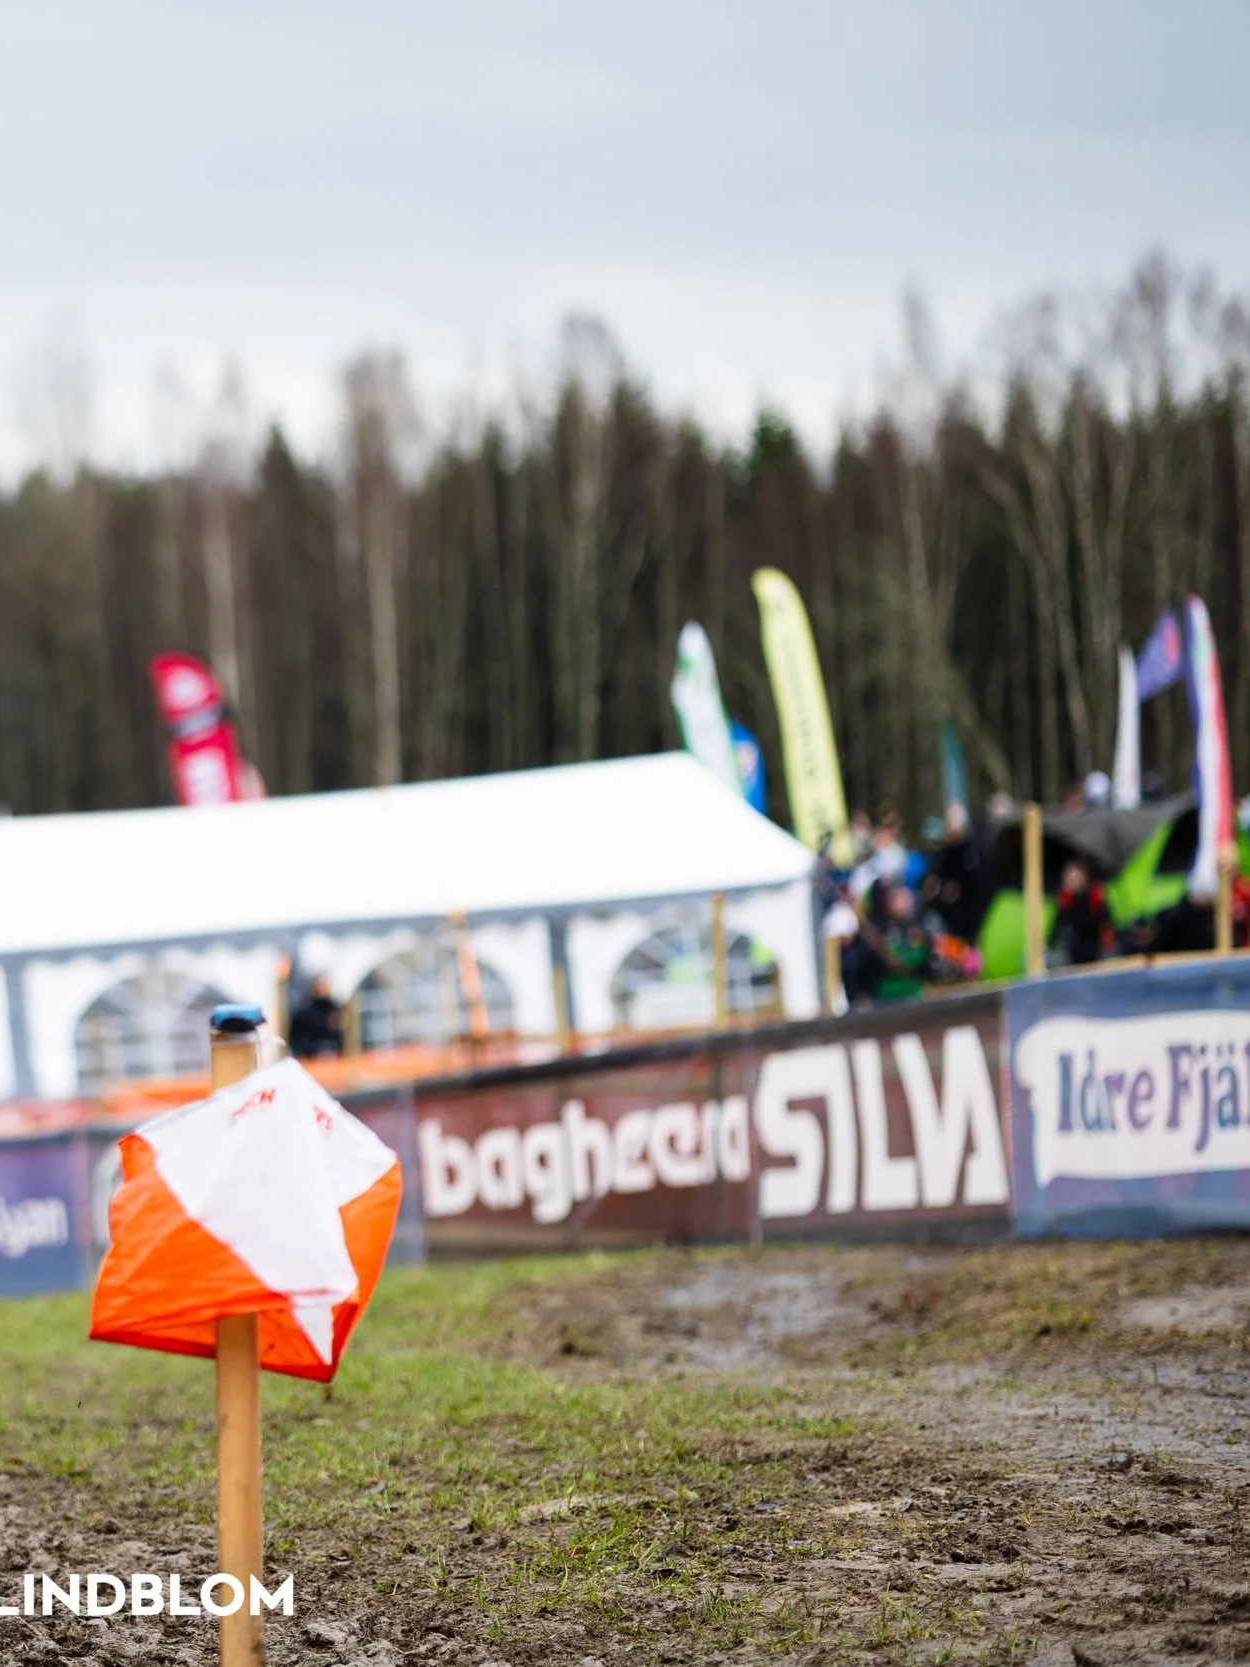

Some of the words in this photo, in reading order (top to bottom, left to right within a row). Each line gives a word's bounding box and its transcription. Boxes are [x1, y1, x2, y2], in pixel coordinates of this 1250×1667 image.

[418, 1096, 750, 1224] bagheera
[754, 1025, 1011, 1219] SILVA
[1058, 1046, 1154, 1132] Idre
[1165, 1041, 1250, 1154] Fjä
